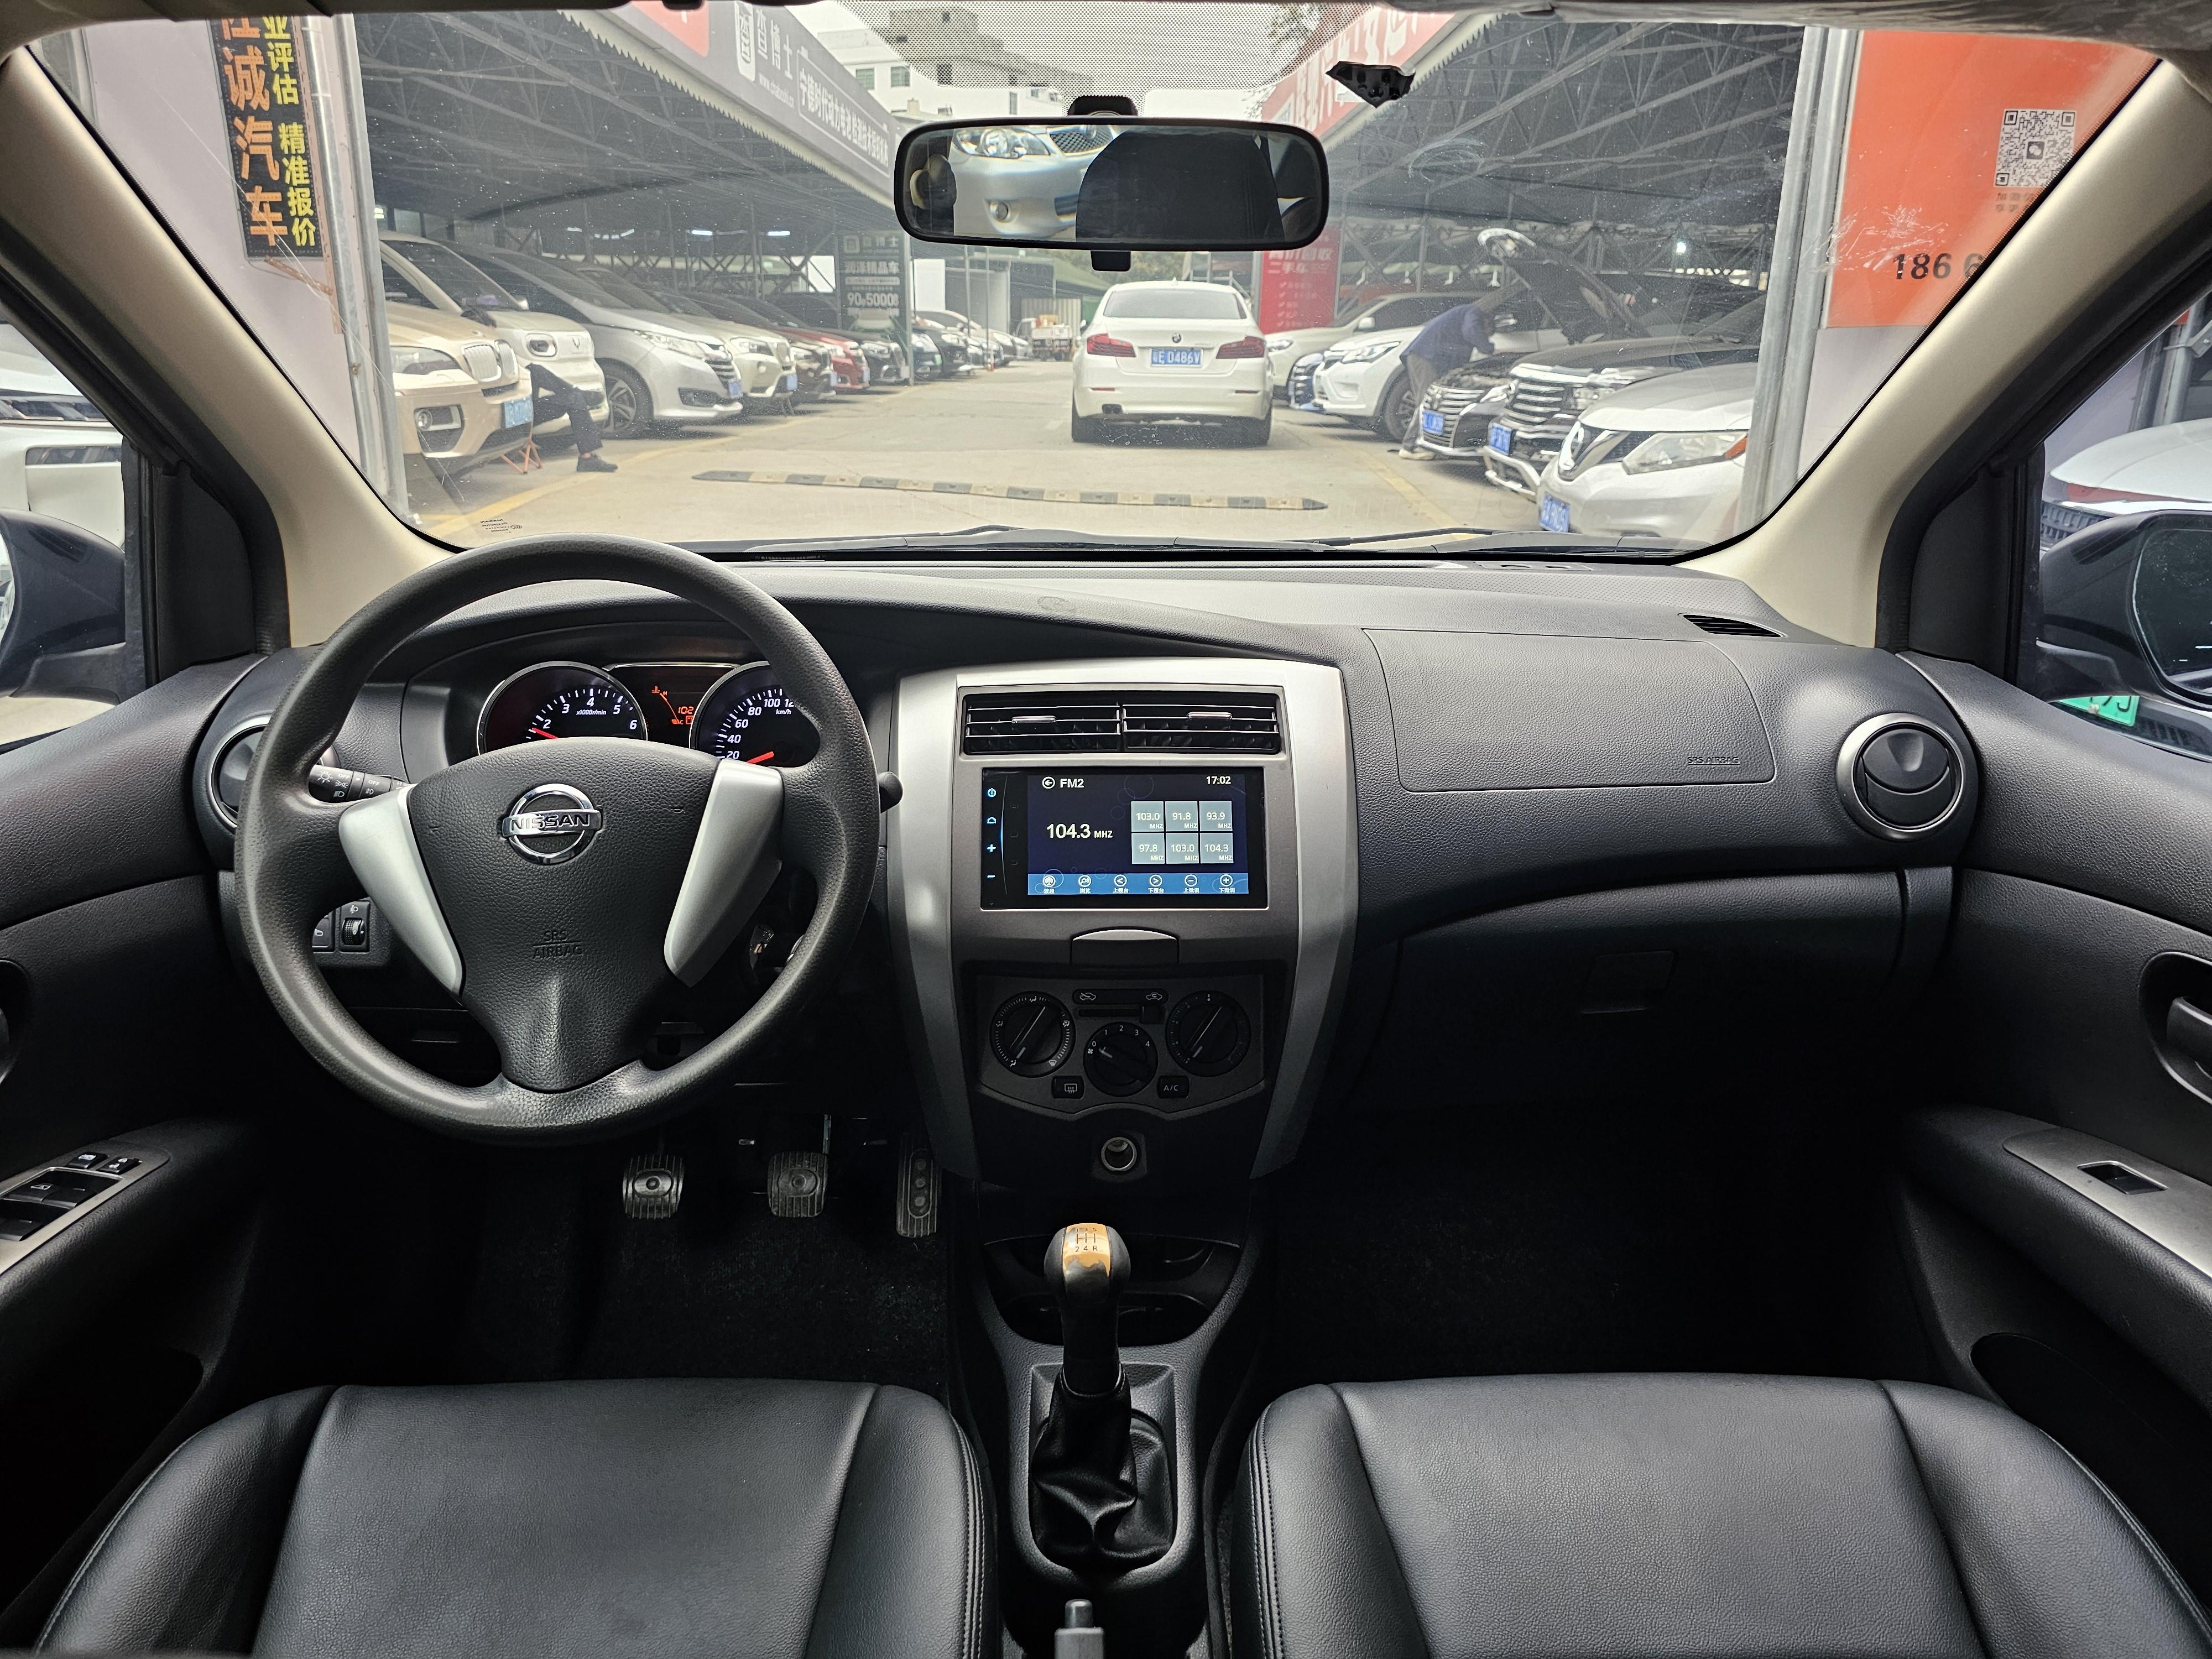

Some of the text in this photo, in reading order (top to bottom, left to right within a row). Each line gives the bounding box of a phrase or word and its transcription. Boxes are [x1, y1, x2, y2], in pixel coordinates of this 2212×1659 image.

[278, 122, 316, 246] 精准报价
[1893, 252, 1952, 280] 186
[586, 697, 594, 707] 4
[764, 698, 781, 707] 100
[784, 698, 795, 707] 12
[561, 703, 570, 714] 3
[613, 705, 621, 714] 5
[748, 707, 762, 716] 80
[542, 719, 551, 729] 2
[629, 719, 638, 729] 6
[735, 719, 749, 728] 60
[727, 734, 742, 743] 40
[726, 750, 740, 759] 20
[1060, 778, 1084, 788] FM2
[1206, 776, 1232, 785] 17:02
[1136, 812, 1160, 821] 103.0
[1172, 812, 1191, 821] 91.8
[1206, 812, 1225, 820] 93.9
[510, 813, 590, 831] NISSAN
[1047, 823, 1113, 838] 104.3 MHZ
[1139, 844, 1158, 852] 97.8
[1171, 844, 1195, 852] 103.0
[1204, 844, 1229, 852] 104.3
[532, 945, 583, 960] AIRBAG
